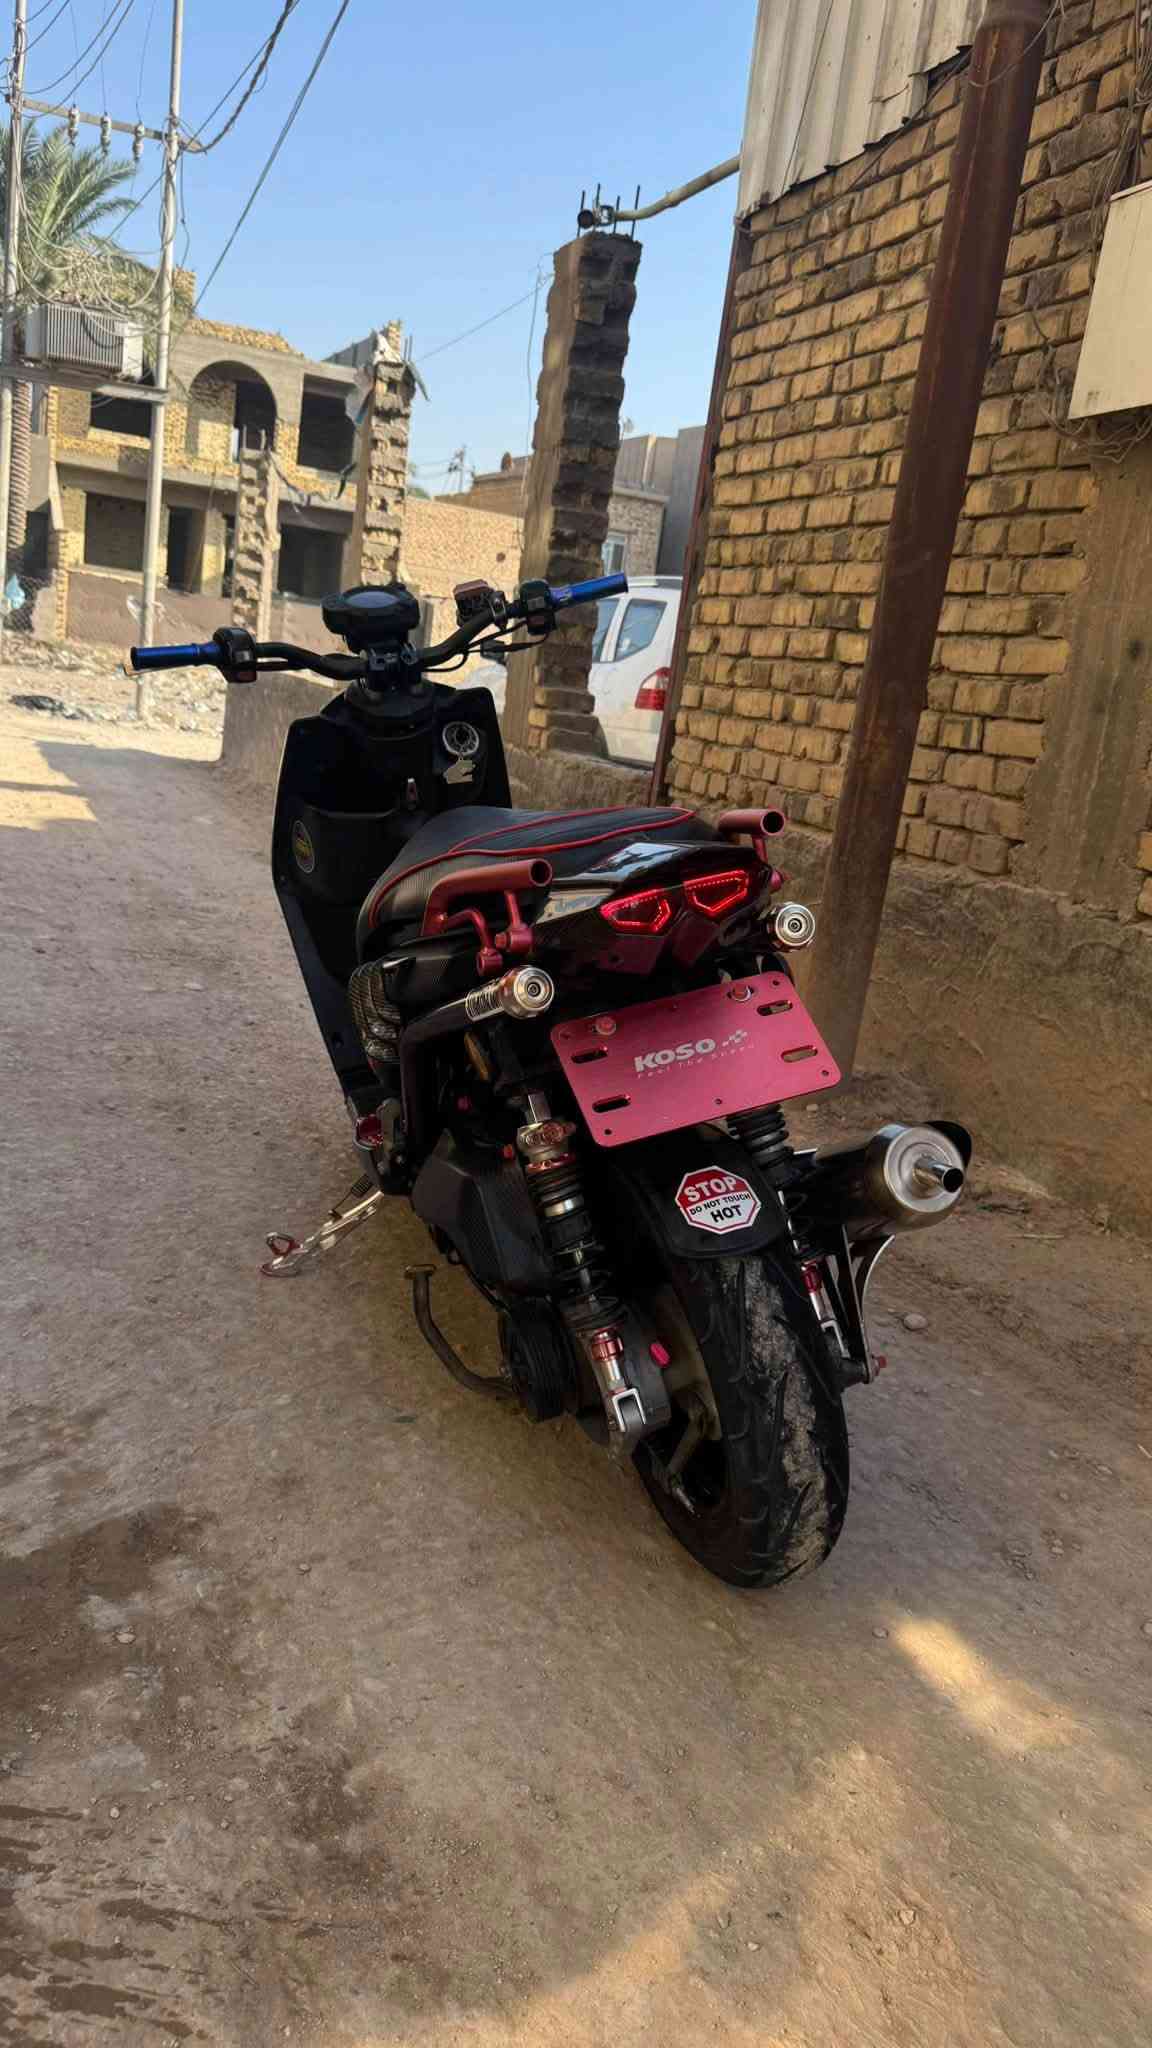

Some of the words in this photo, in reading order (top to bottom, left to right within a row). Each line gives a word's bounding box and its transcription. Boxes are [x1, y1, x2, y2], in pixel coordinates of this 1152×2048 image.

[634, 1039, 716, 1072] KOSO
[684, 1176, 736, 1202] STOP
[689, 1205, 703, 1216] DO
[703, 1199, 721, 1210] NOT
[722, 1192, 751, 1204] TOUCH
[710, 1205, 742, 1223] HOT
